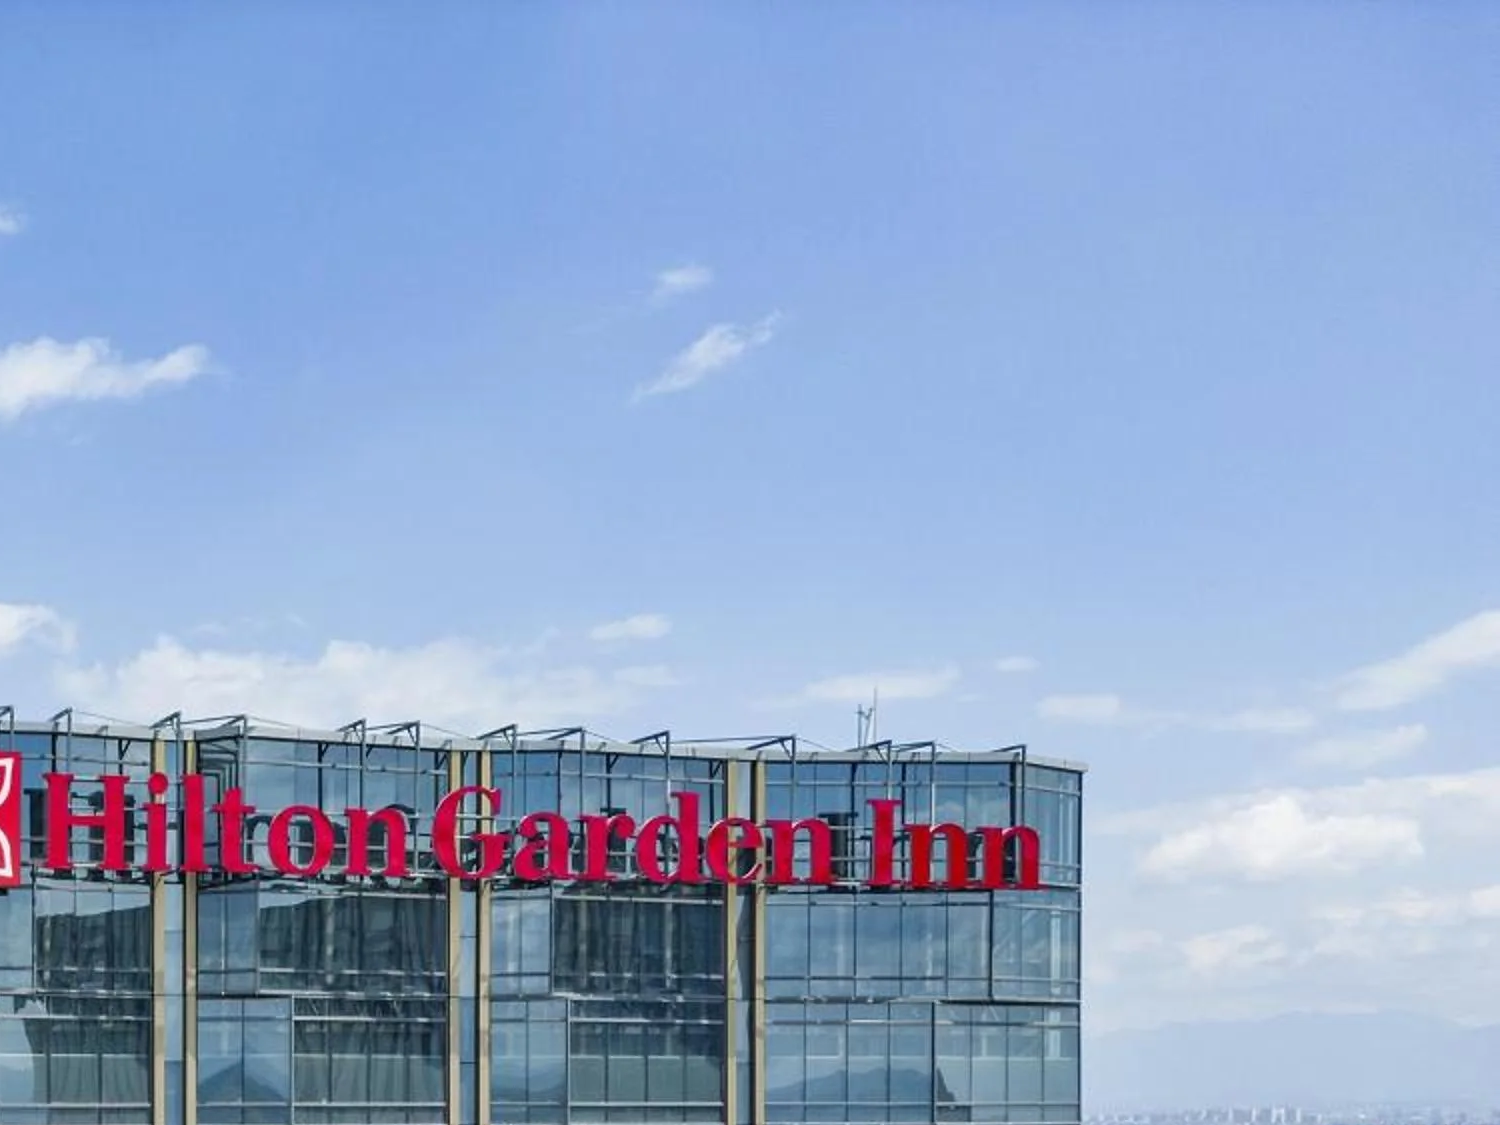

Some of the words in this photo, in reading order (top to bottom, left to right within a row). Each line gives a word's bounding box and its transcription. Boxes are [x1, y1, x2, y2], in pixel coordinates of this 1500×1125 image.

[43, 771, 411, 877] Hilton
[432, 785, 835, 885] Garden
[866, 799, 1044, 890] Inn
